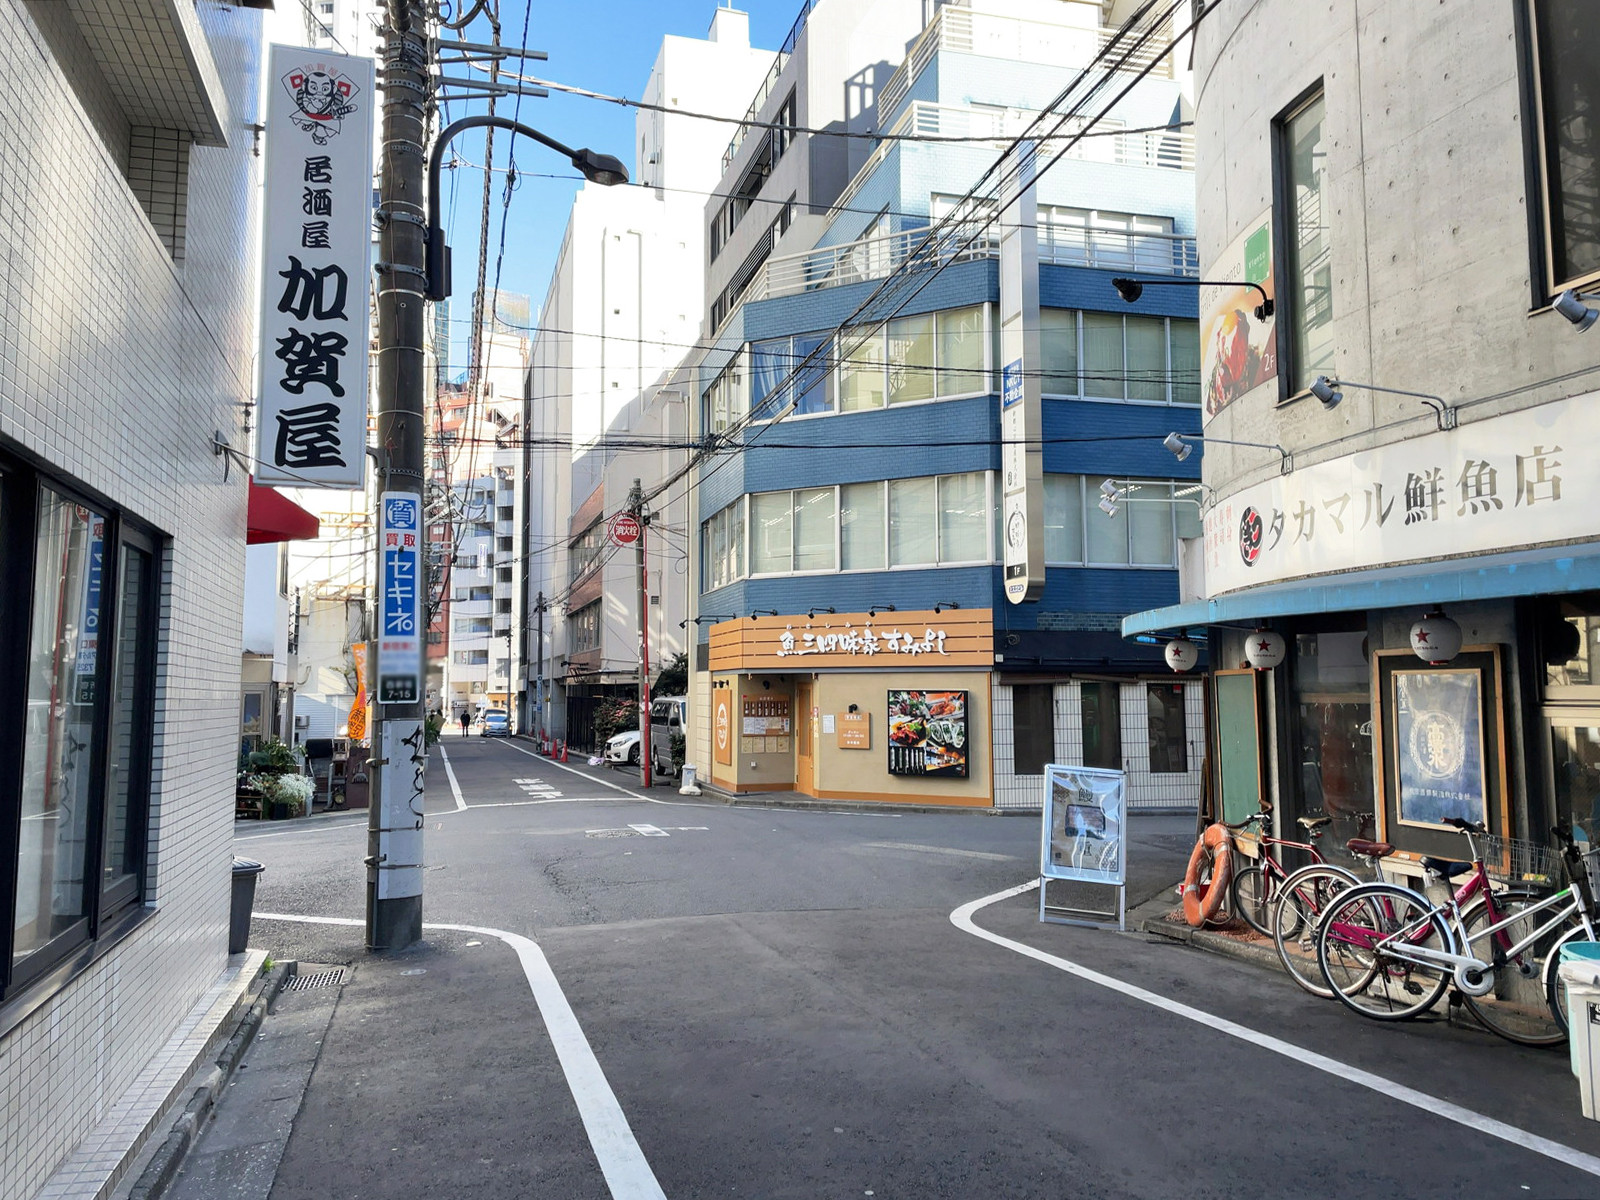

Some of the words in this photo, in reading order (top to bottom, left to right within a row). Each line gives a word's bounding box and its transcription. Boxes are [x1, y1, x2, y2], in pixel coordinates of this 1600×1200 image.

[302, 155, 333, 249] 居酒屋
[274, 255, 349, 468] 加賀屋
[1264, 353, 1275, 371] 2F
[1268, 444, 1564, 551] タカマル鮮魚店
[389, 501, 414, 526] 質
[386, 533, 416, 547] 買取
[616, 524, 638, 536] 消火栓
[1013, 566, 1021, 576] 1F
[387, 554, 413, 632] セキネ
[388, 690, 411, 699] 7-15
